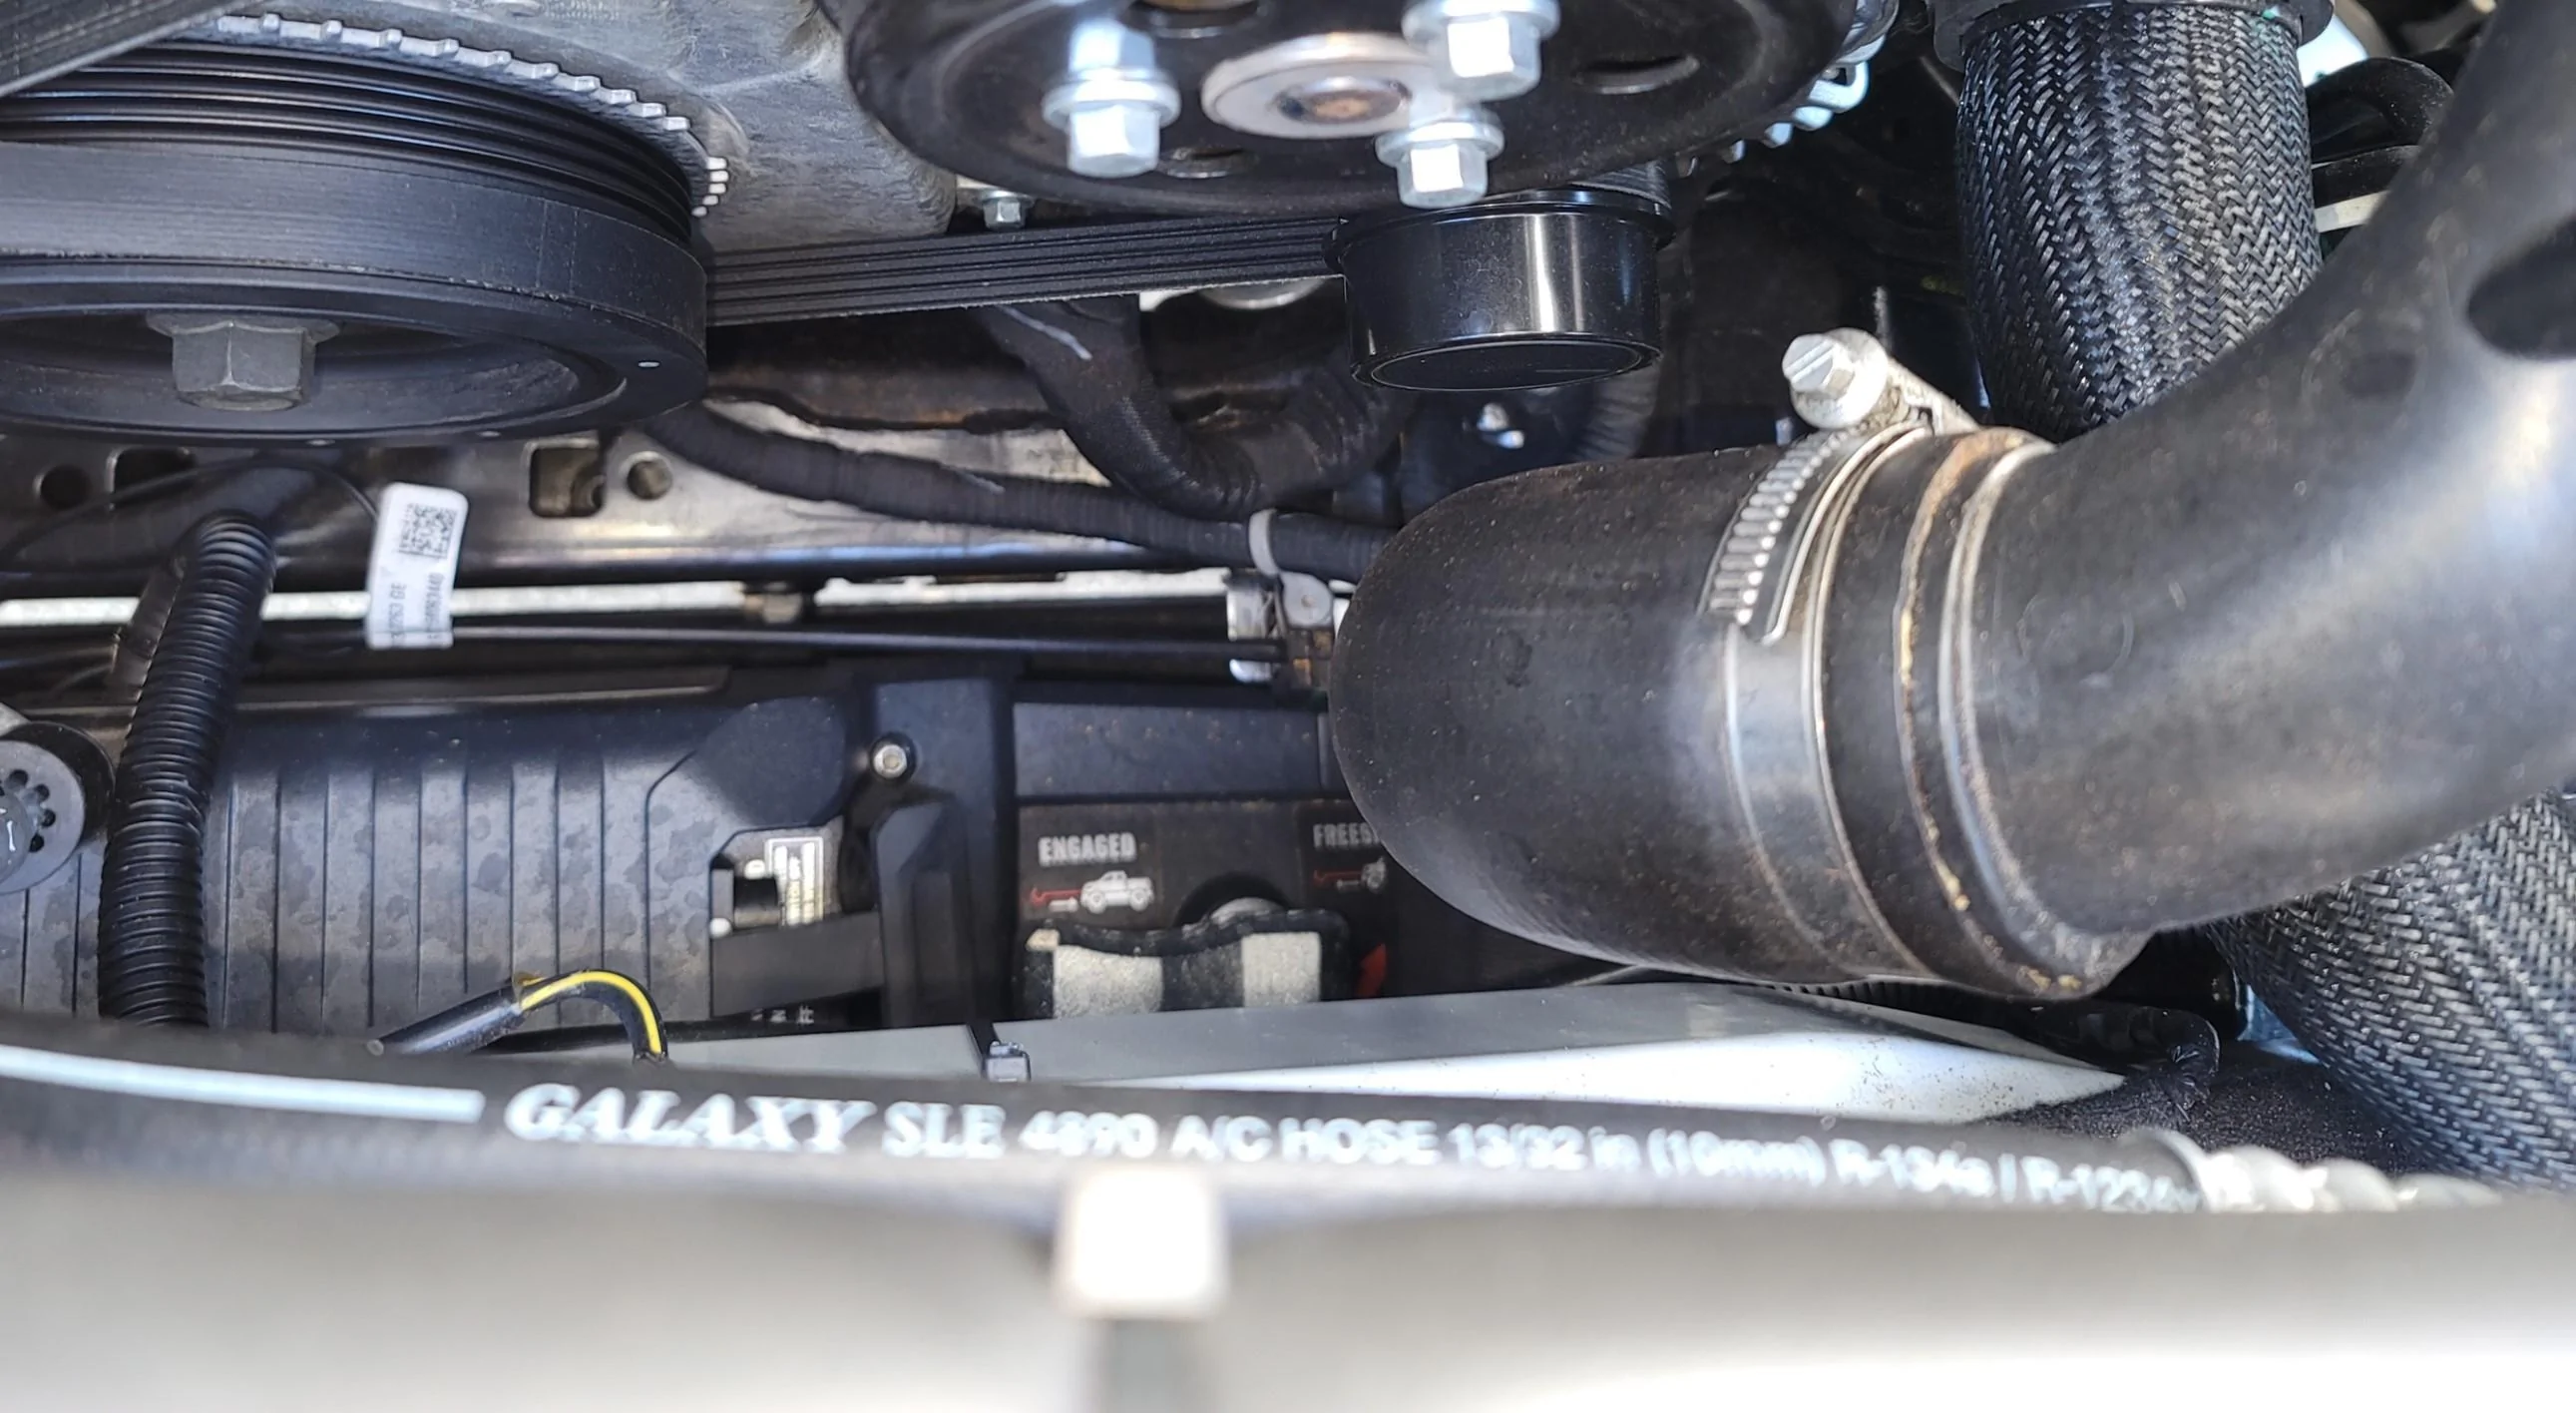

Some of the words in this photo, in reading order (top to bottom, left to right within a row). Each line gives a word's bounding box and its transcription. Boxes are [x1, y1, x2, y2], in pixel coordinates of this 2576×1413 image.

[1038, 831, 1138, 867] ENGAGED
[504, 1083, 876, 1155] GALAXY
[881, 1101, 1007, 1160] SLE
[1170, 1115, 1274, 1165] A/C
[1279, 1117, 1444, 1167] HOSE
[1448, 1123, 1588, 1173] 13/32
[1647, 1128, 1827, 1187] (10mm)
